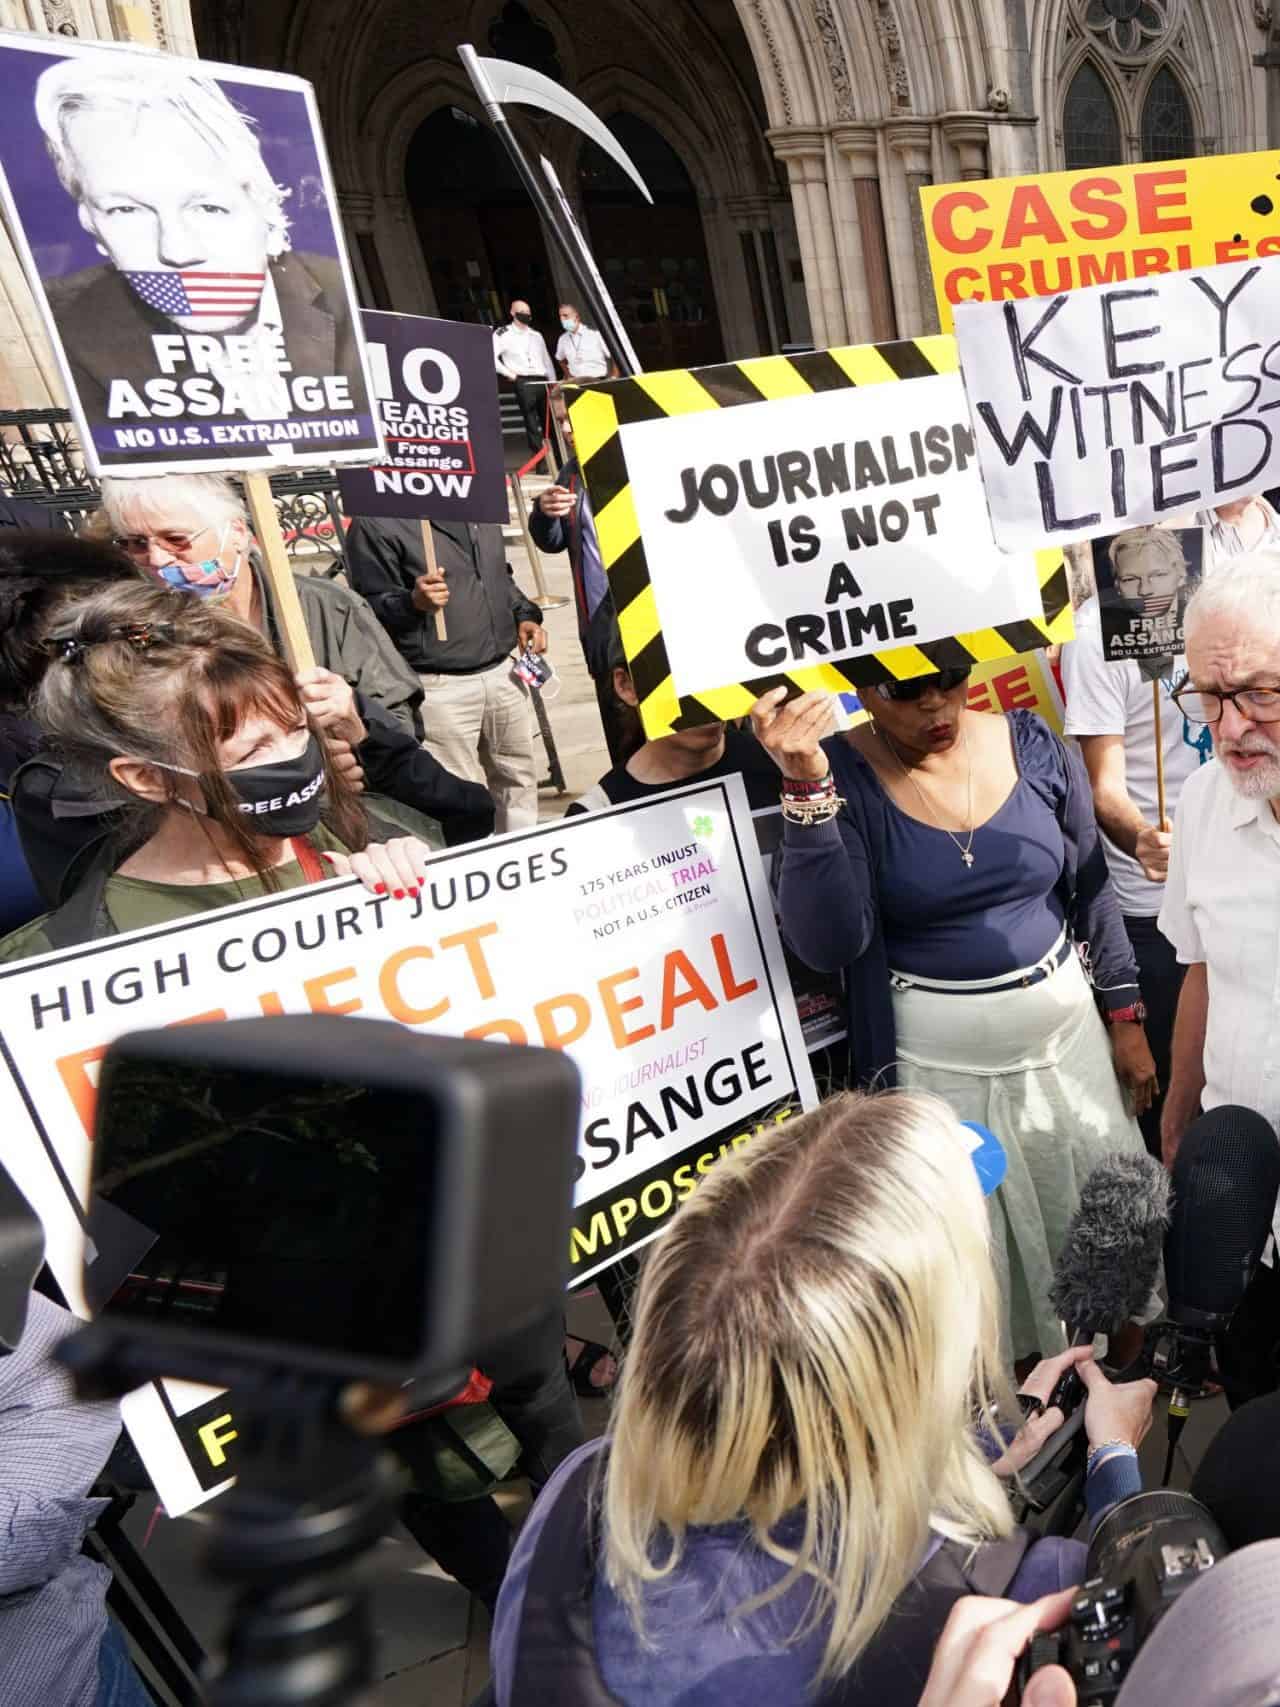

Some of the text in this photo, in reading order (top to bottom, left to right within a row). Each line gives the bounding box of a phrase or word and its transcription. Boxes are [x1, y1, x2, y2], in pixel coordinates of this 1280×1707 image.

[931, 169, 1193, 255] CASE
[151, 334, 292, 374] FREE
[1003, 266, 1262, 401] KEY
[107, 376, 354, 419] ASSANGE
[377, 400, 469, 427] EARS
[114, 419, 360, 448] NO U.S. EXTRADITION
[382, 421, 469, 443] NOUGH
[397, 442, 441, 455] Free
[373, 470, 473, 499] NOW
[383, 456, 463, 472] Assange
[767, 494, 941, 567] IS NOT
[825, 562, 862, 604] A
[744, 598, 917, 667] CRIME
[1110, 629, 1185, 647] ASSANG
[1129, 617, 1178, 633] FREE
[1111, 649, 1123, 657] NO
[1144, 643, 1185, 655] EXTRADIT
[238, 797, 283, 815] REE
[580, 843, 699, 896] 175 YEARS UNJUST
[573, 878, 668, 926] POLITICAL
[672, 859, 720, 887] TRIAL
[593, 919, 621, 939] NOT
[625, 915, 636, 928] A
[637, 905, 663, 922] U.S.
[665, 883, 711, 910] CITIZEN
[30, 846, 569, 1029] HIGH COURT JUDGES
[464, 931, 759, 1052] PEAL
[574, 1041, 773, 1184] SANGE
